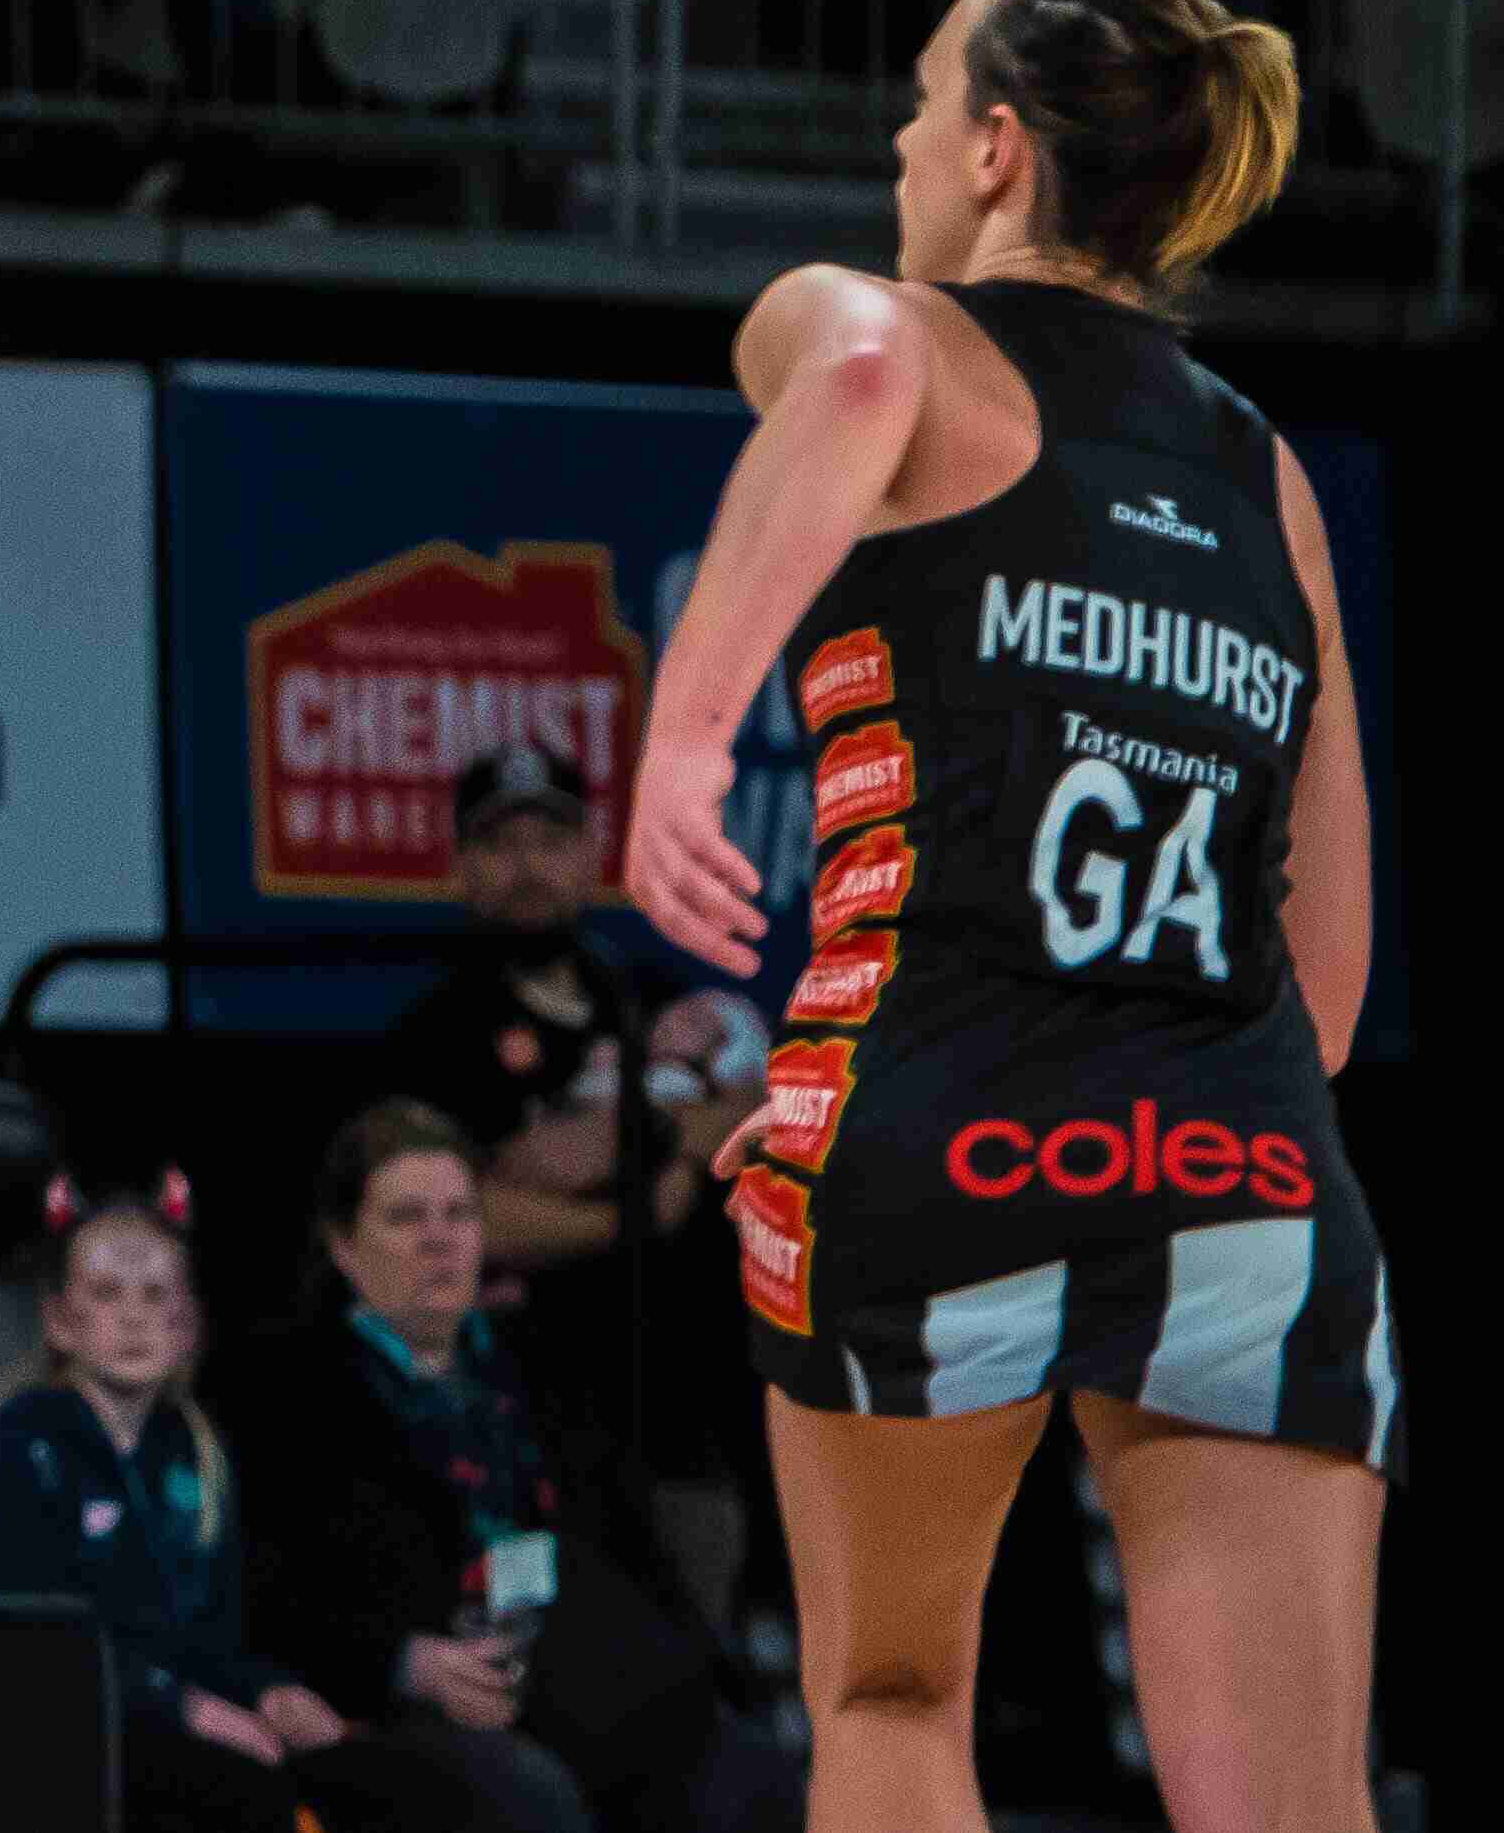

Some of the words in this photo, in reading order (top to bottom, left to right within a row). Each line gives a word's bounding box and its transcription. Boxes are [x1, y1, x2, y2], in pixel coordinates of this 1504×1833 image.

[977, 572, 1305, 745] MEDHURST
[1062, 709, 1240, 798] Tasmania
[1029, 758, 1231, 982] GA
[945, 1097, 1315, 1209] coles
